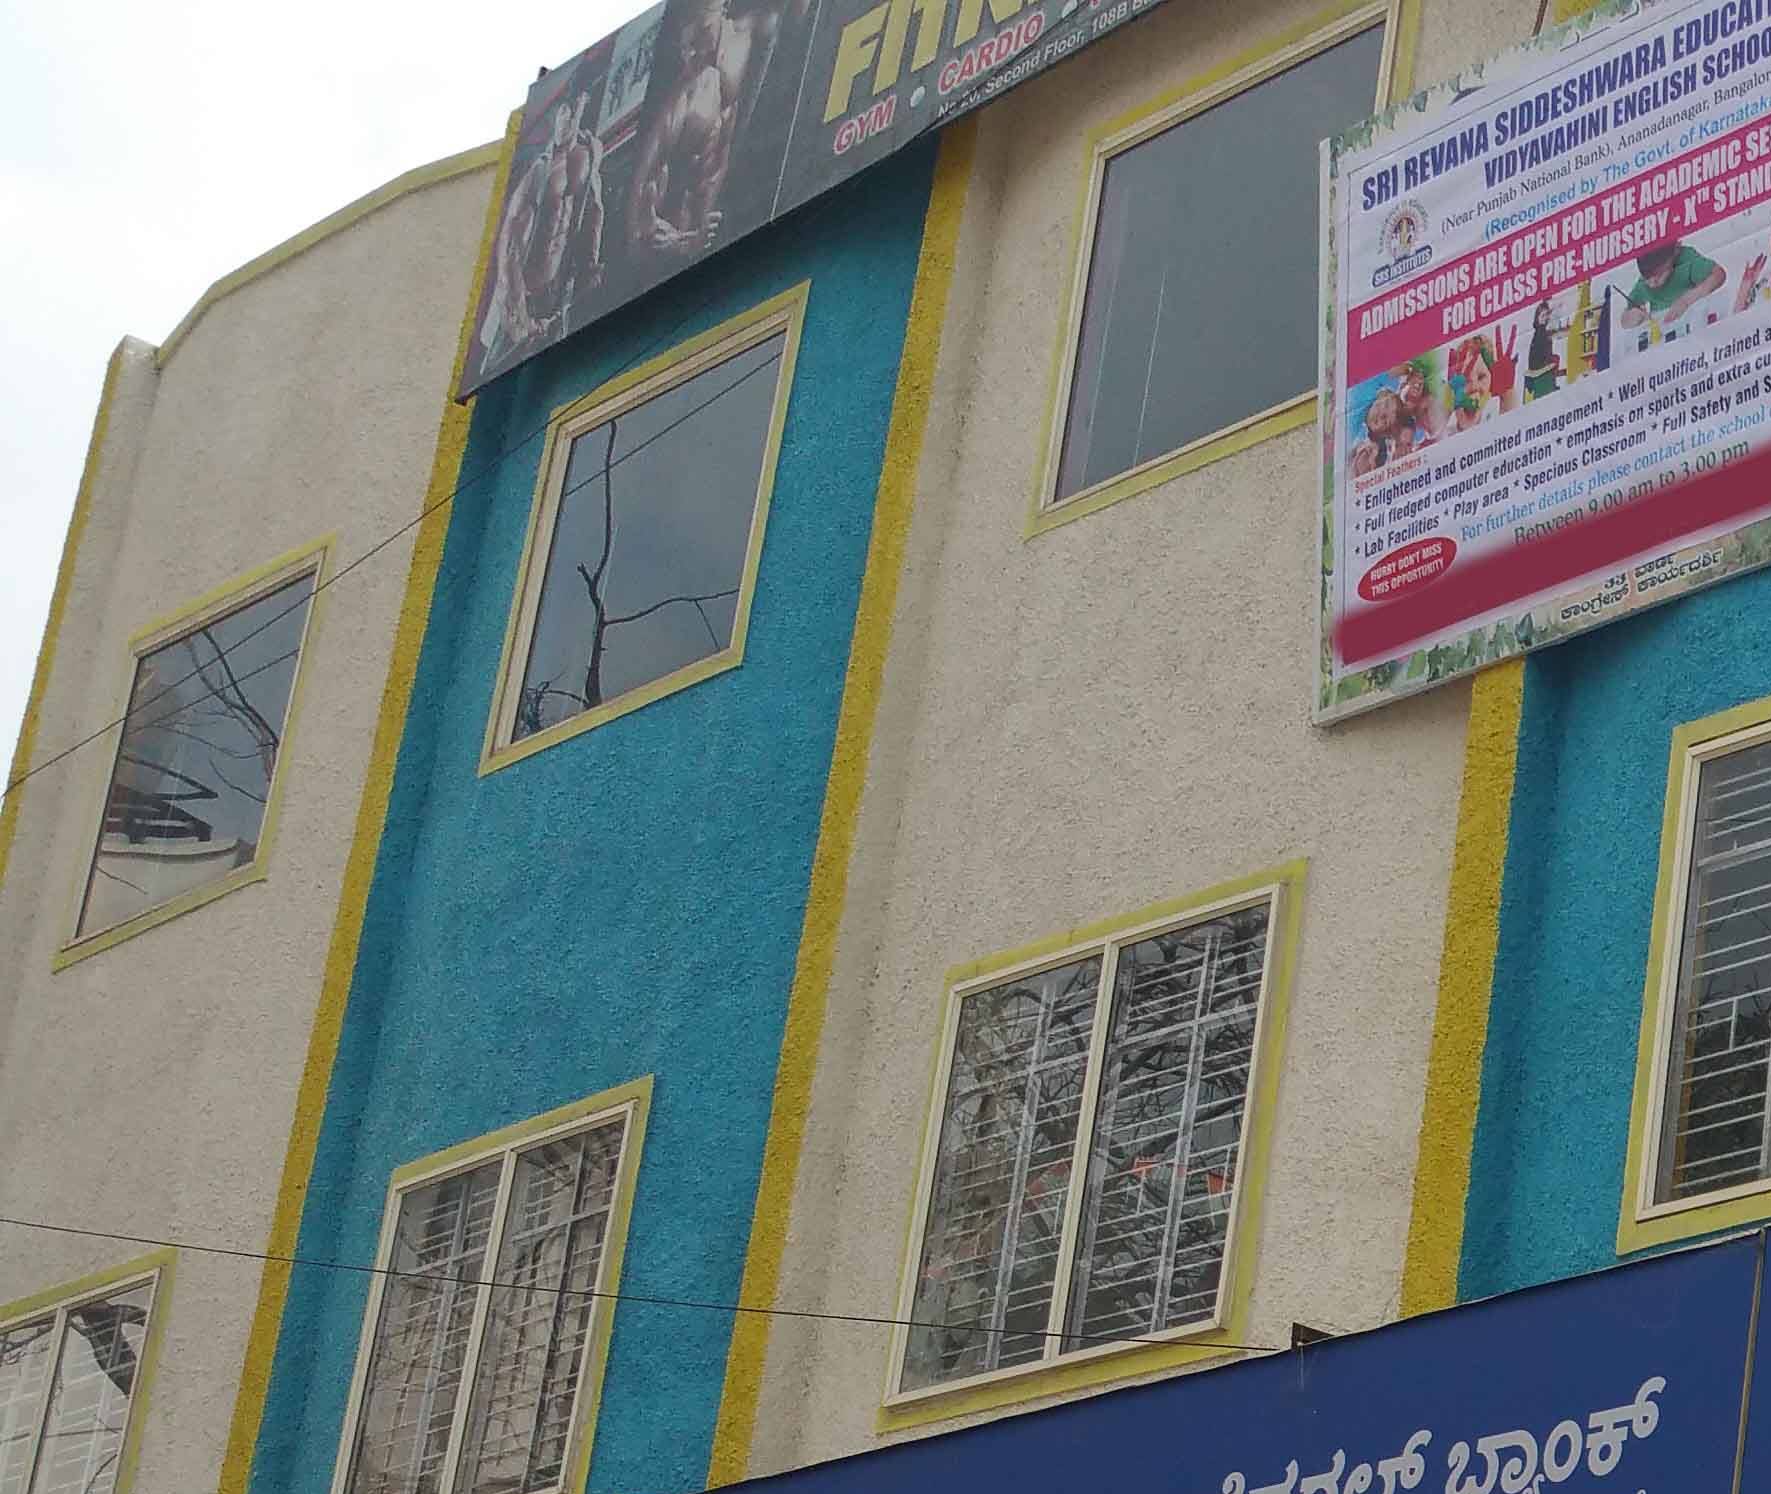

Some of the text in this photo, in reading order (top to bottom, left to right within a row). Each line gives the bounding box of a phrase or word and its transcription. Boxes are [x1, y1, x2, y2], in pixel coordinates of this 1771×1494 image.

[833, 9, 1045, 155] GYM CARDIO
[1363, 36, 1665, 210] SRI REVANA SIDDESHWARA
[1484, 105, 1607, 188] VIDYAVAHINI
[1613, 63, 1696, 128] ENGLISH
[1360, 264, 1469, 338] ADMISSIONS
[1474, 245, 1507, 285] ARE
[1511, 223, 1557, 267] OPEN
[1562, 206, 1596, 244] FOR
[1601, 186, 1635, 225] THE
[1641, 139, 1740, 209] ACADEMIC
[1443, 296, 1475, 334] FOR
[1480, 268, 1537, 316] CLASS
[1542, 207, 1668, 289] PRE-NURSERY
[1364, 537, 1383, 557] Lab
[1388, 515, 1438, 547] Facilities
[1454, 499, 1478, 519] Play
[1483, 486, 1508, 507] area
[1524, 458, 1577, 490] Specious
[1582, 430, 1645, 465] Classroom
[1663, 410, 1685, 433] Full
[1691, 395, 1730, 422] Safety
[1736, 380, 1758, 404] and
